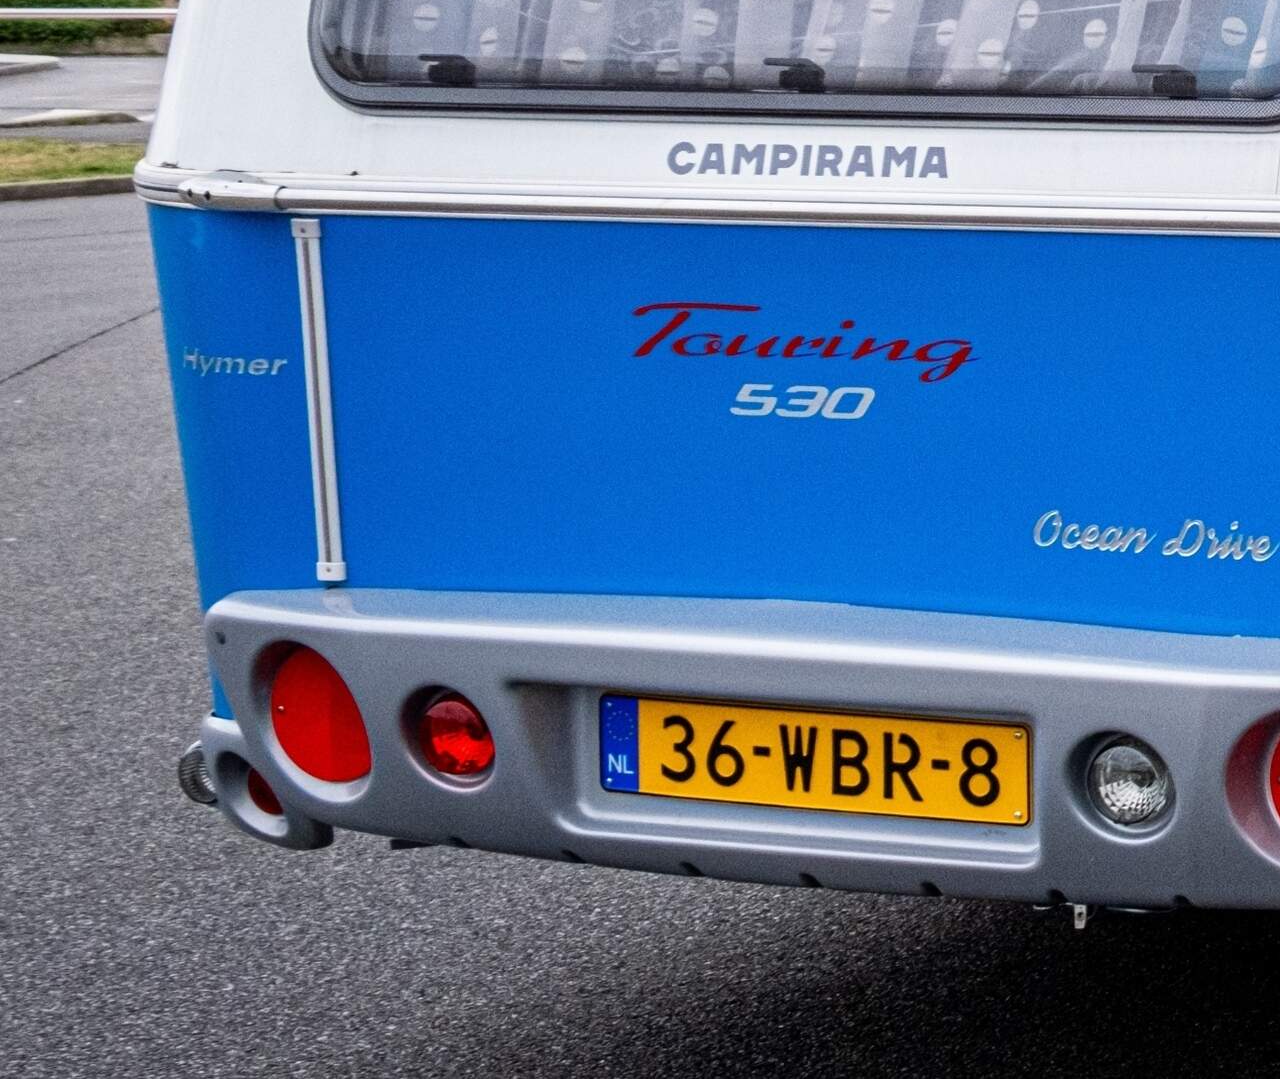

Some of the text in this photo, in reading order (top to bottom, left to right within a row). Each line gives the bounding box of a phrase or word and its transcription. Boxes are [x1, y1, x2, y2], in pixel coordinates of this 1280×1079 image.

[666, 140, 949, 180] CAMPIRAMA
[182, 346, 289, 377] Hymer
[632, 301, 981, 383] Touring
[729, 383, 876, 421] 530
[1033, 509, 1280, 563] Ocean Drive
[607, 752, 635, 776] NL
[660, 715, 1001, 808] 36-WBR-8
